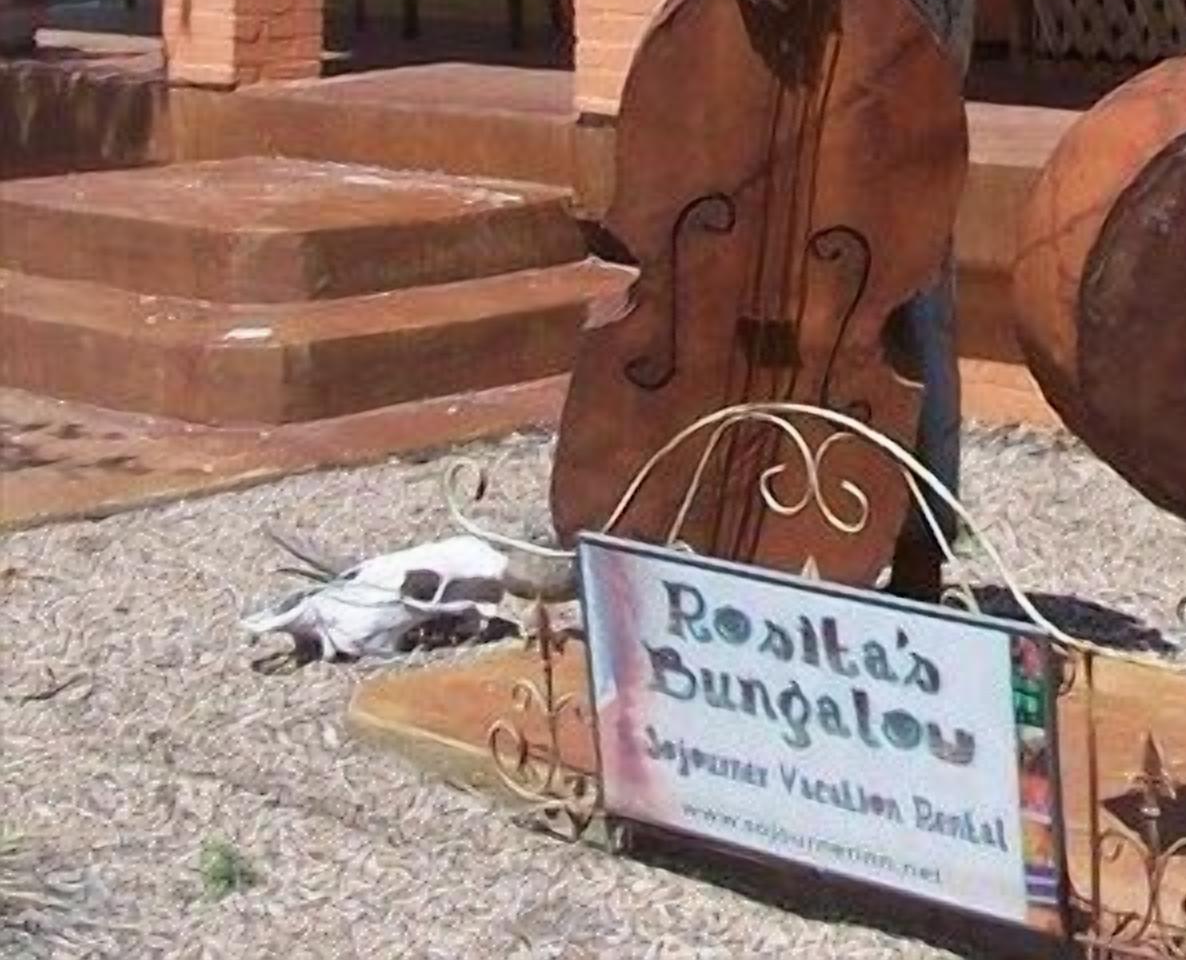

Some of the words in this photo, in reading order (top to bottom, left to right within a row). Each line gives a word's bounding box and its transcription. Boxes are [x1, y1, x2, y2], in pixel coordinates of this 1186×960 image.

[660, 578, 942, 695] Rosita's
[644, 724, 769, 788] Sojourner
[779, 762, 904, 824] Vacation
[911, 794, 1009, 853] Rental
